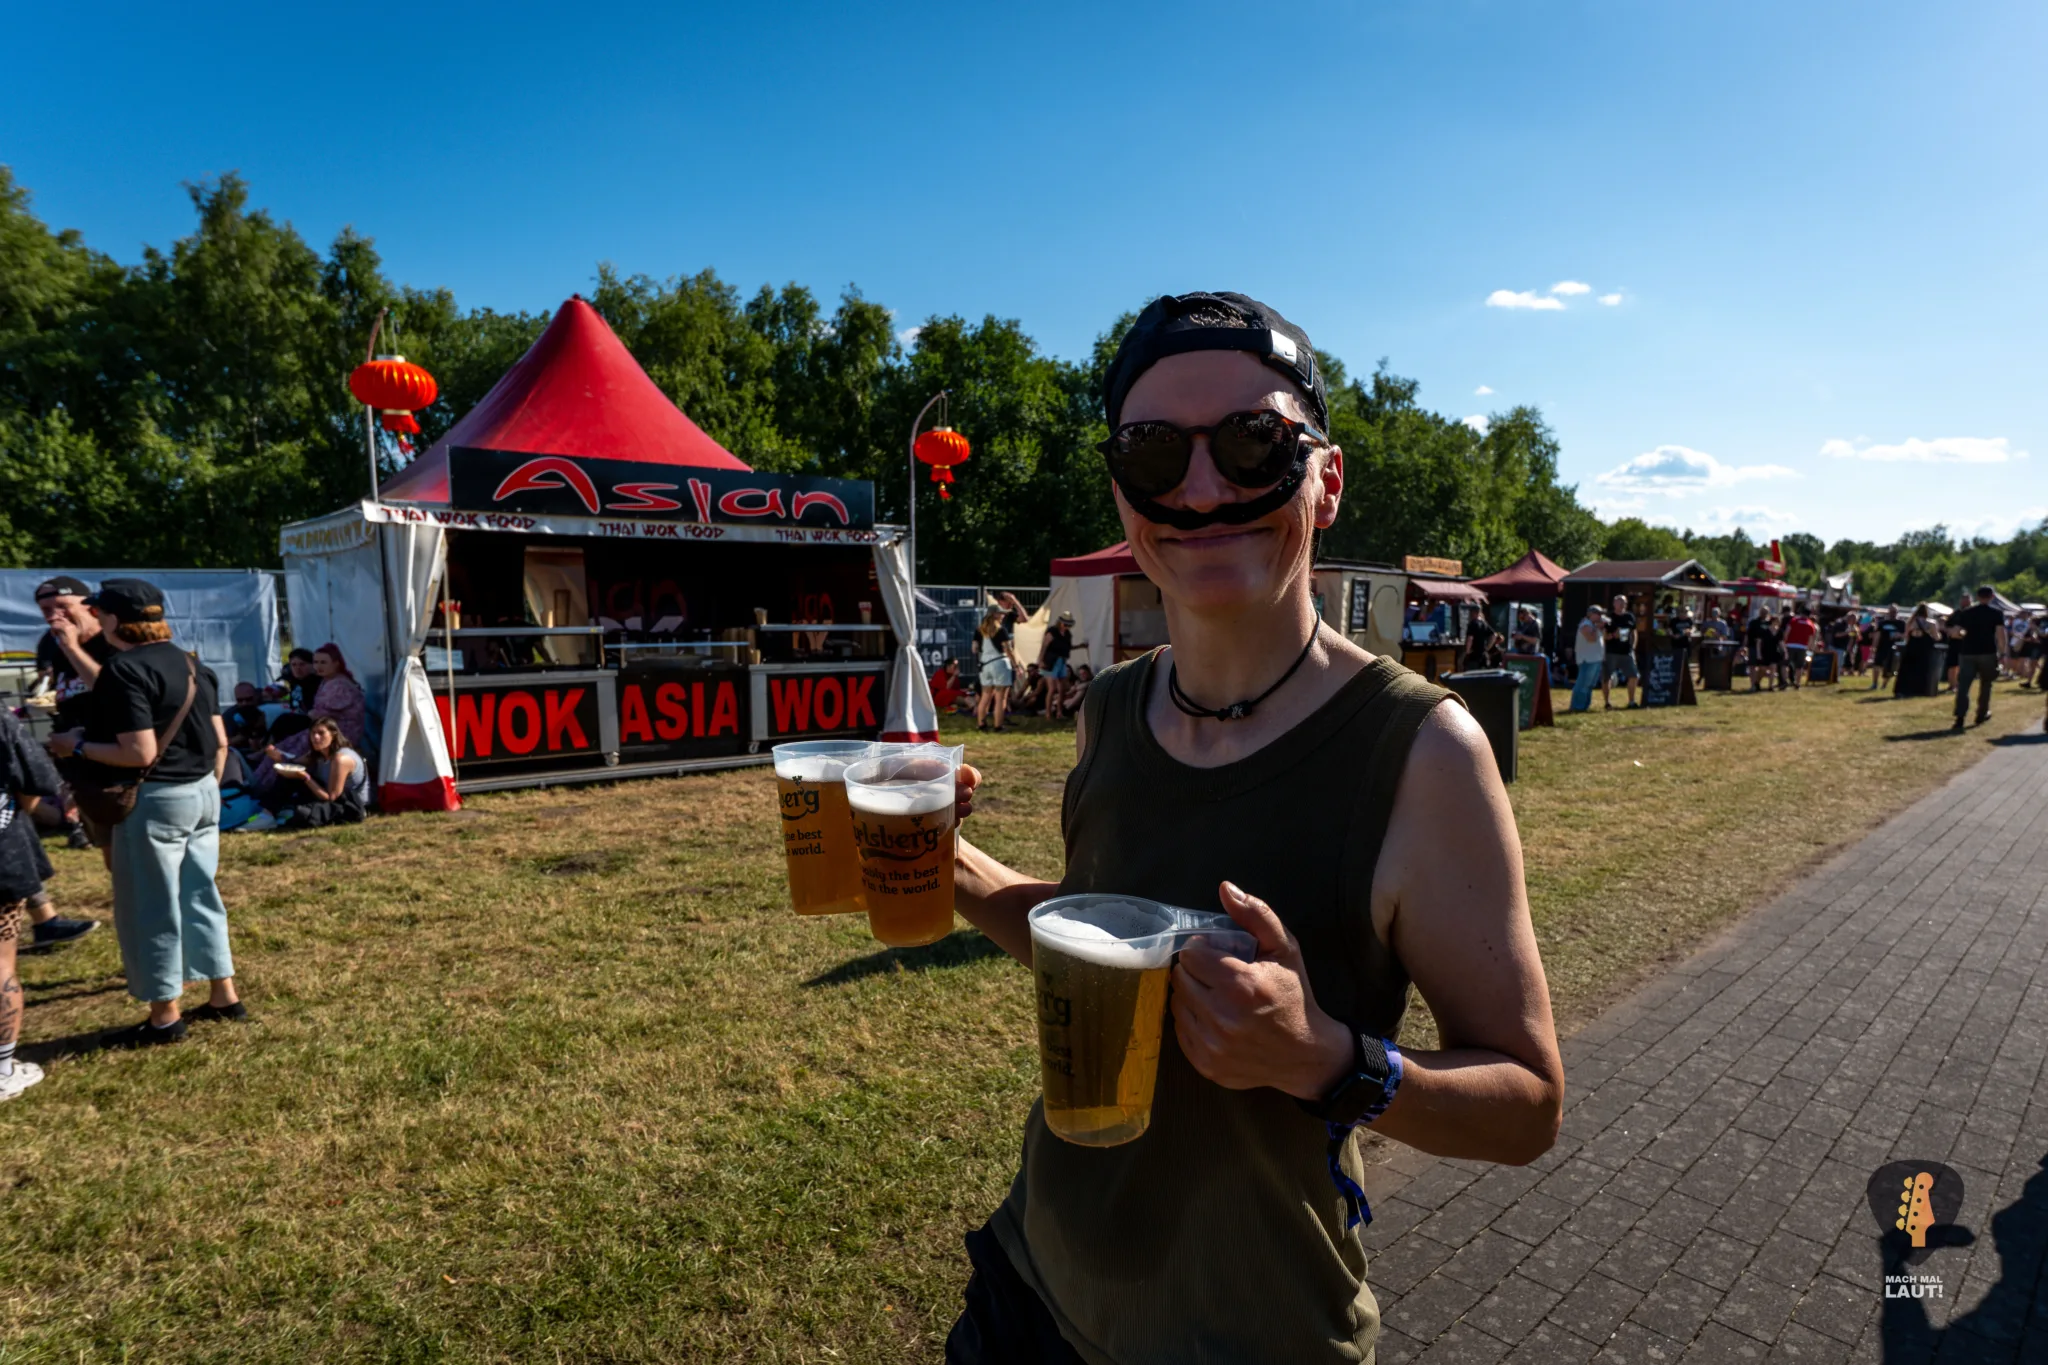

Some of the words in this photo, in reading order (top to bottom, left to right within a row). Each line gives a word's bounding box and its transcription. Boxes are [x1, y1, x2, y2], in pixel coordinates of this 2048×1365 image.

[494, 457, 850, 525] Asian
[380, 507, 428, 522] THAI
[434, 512, 480, 527] WOK
[485, 515, 536, 530] FOOD
[599, 522, 636, 536] THAI
[641, 523, 678, 537] WOK
[683, 525, 725, 539] FOOD
[775, 529, 806, 542] THAI
[812, 530, 841, 542] WOK
[847, 530, 880, 543] FOOD
[921, 646, 948, 666] tel
[620, 680, 739, 743] ASIA
[770, 676, 877, 733] WOK
[435, 688, 590, 760] WOK
[797, 829, 823, 842] best
[791, 843, 826, 856] world.
[889, 870, 910, 881] the
[914, 865, 940, 880] best
[878, 883, 899, 895] the
[903, 879, 941, 895] world.
